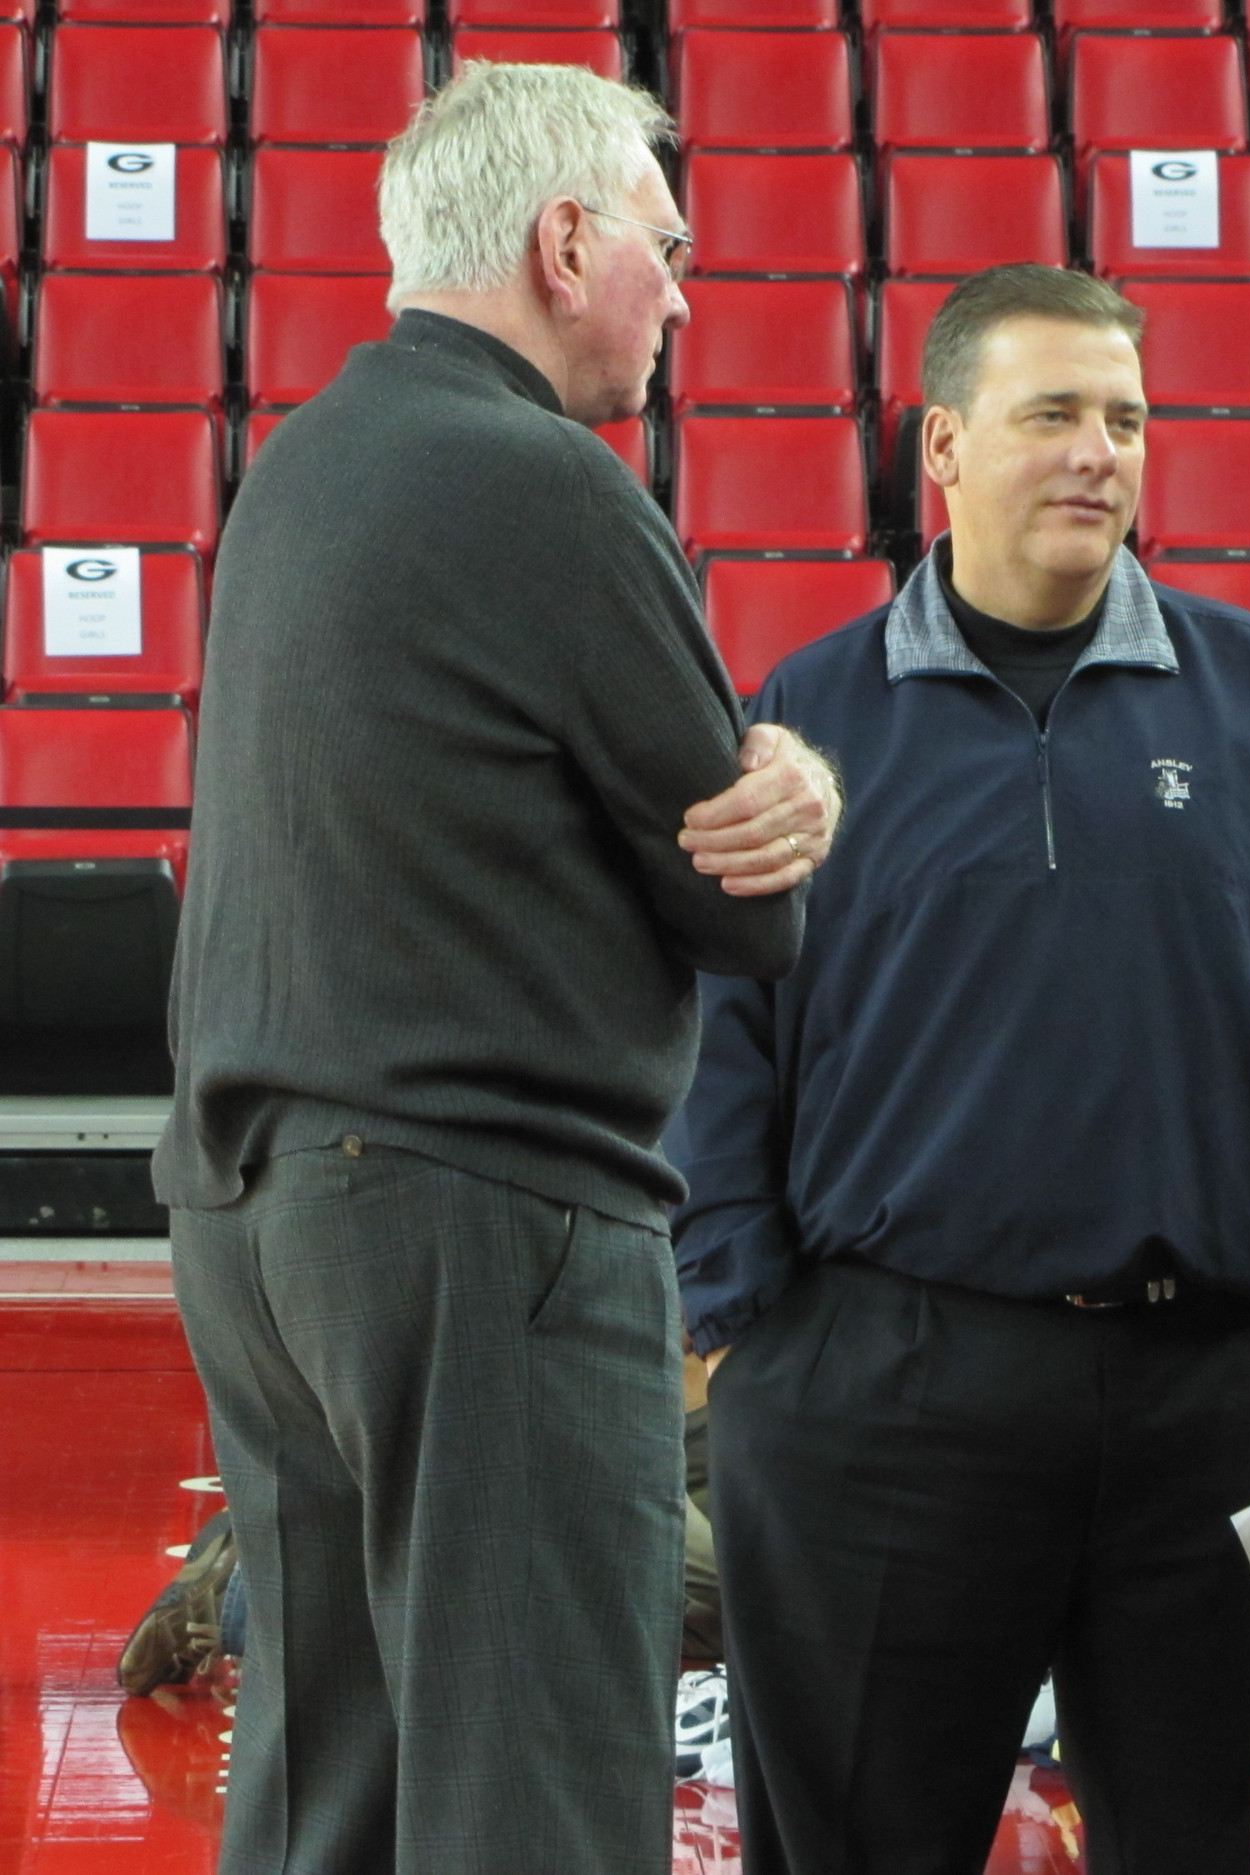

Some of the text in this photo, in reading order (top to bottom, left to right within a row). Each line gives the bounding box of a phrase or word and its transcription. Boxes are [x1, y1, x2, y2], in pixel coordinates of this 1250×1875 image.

[106, 152, 154, 174] G
[1151, 160, 1198, 181] G
[65, 558, 118, 581] G
[68, 591, 117, 600] RESERVED
